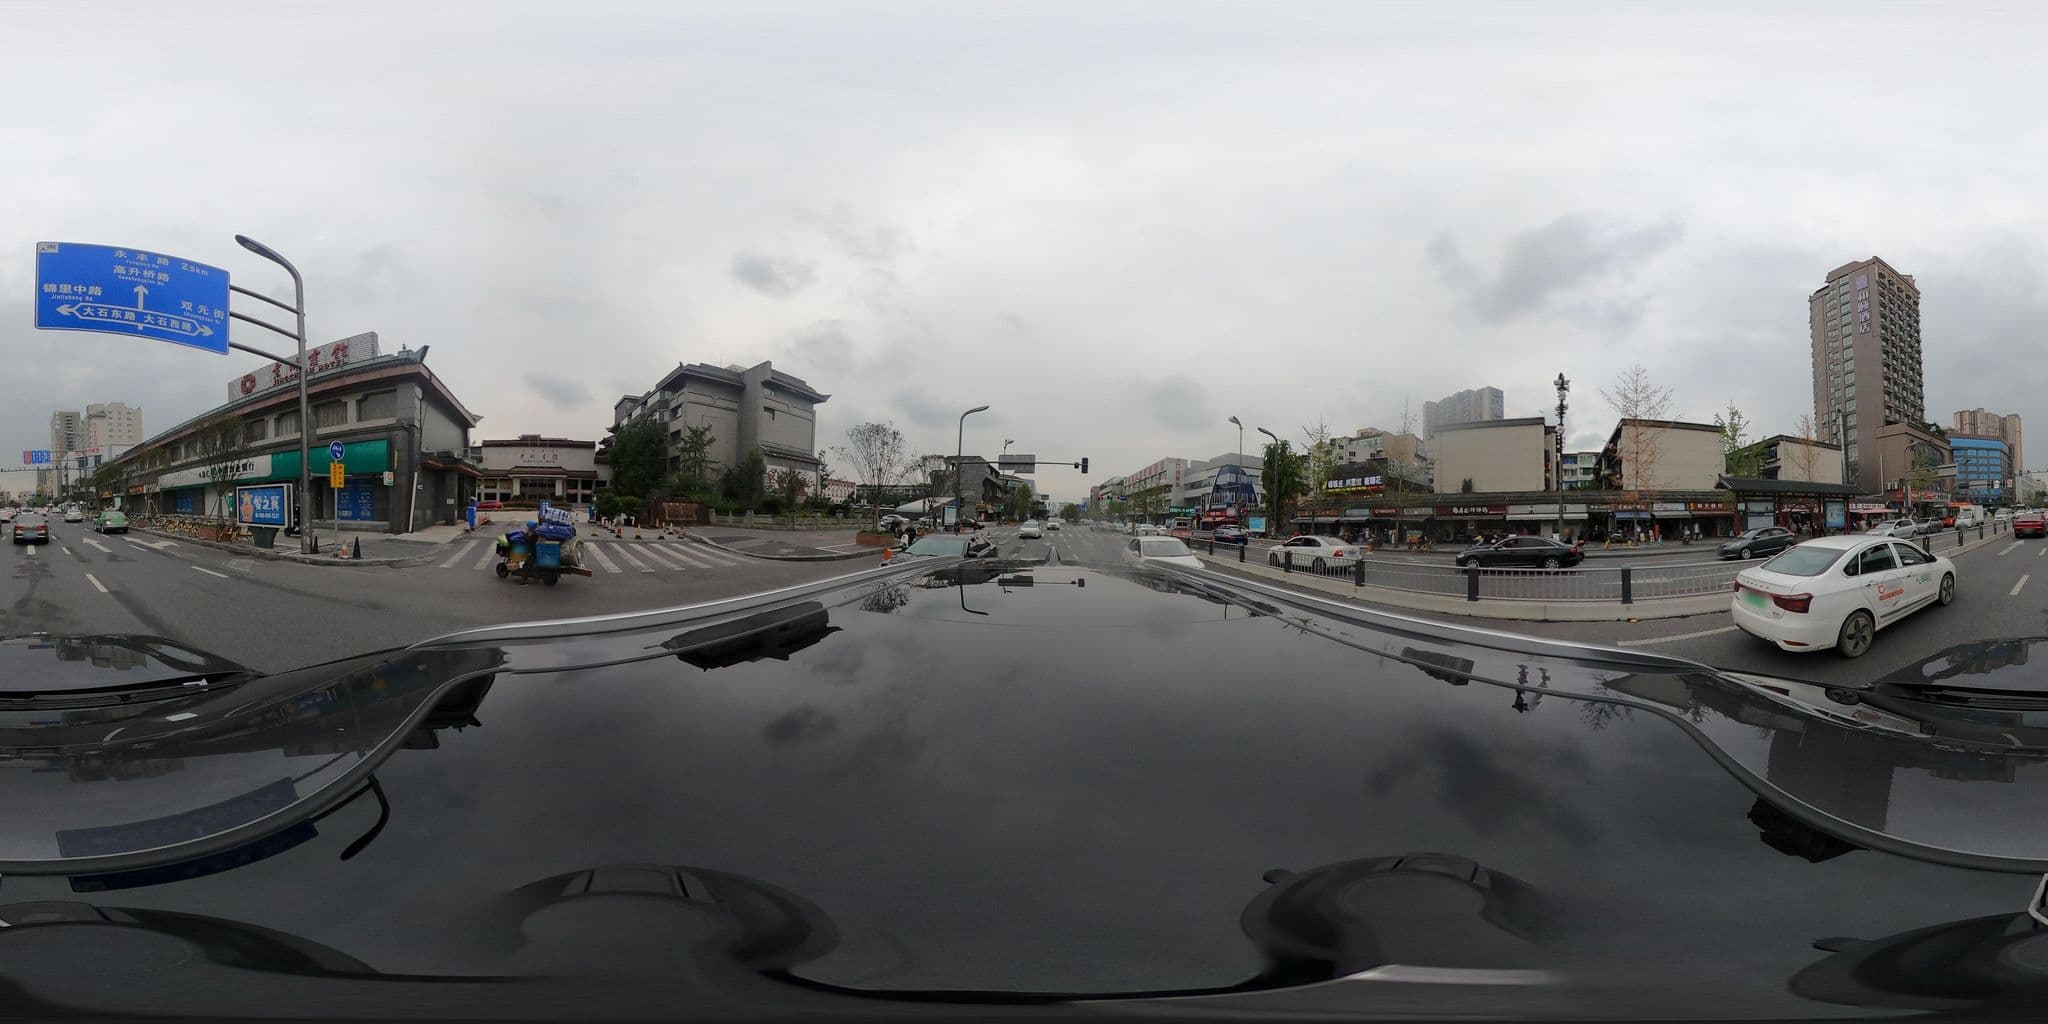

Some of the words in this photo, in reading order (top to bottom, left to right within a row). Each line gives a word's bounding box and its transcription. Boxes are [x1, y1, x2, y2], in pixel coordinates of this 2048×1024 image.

[114, 249, 170, 266] 永丰路
[113, 265, 170, 282] 高升桥路
[43, 283, 102, 297] 锦里中路
[181, 300, 225, 319] 双元街
[83, 306, 136, 321] 大石东路
[144, 313, 193, 332] 大石西路
